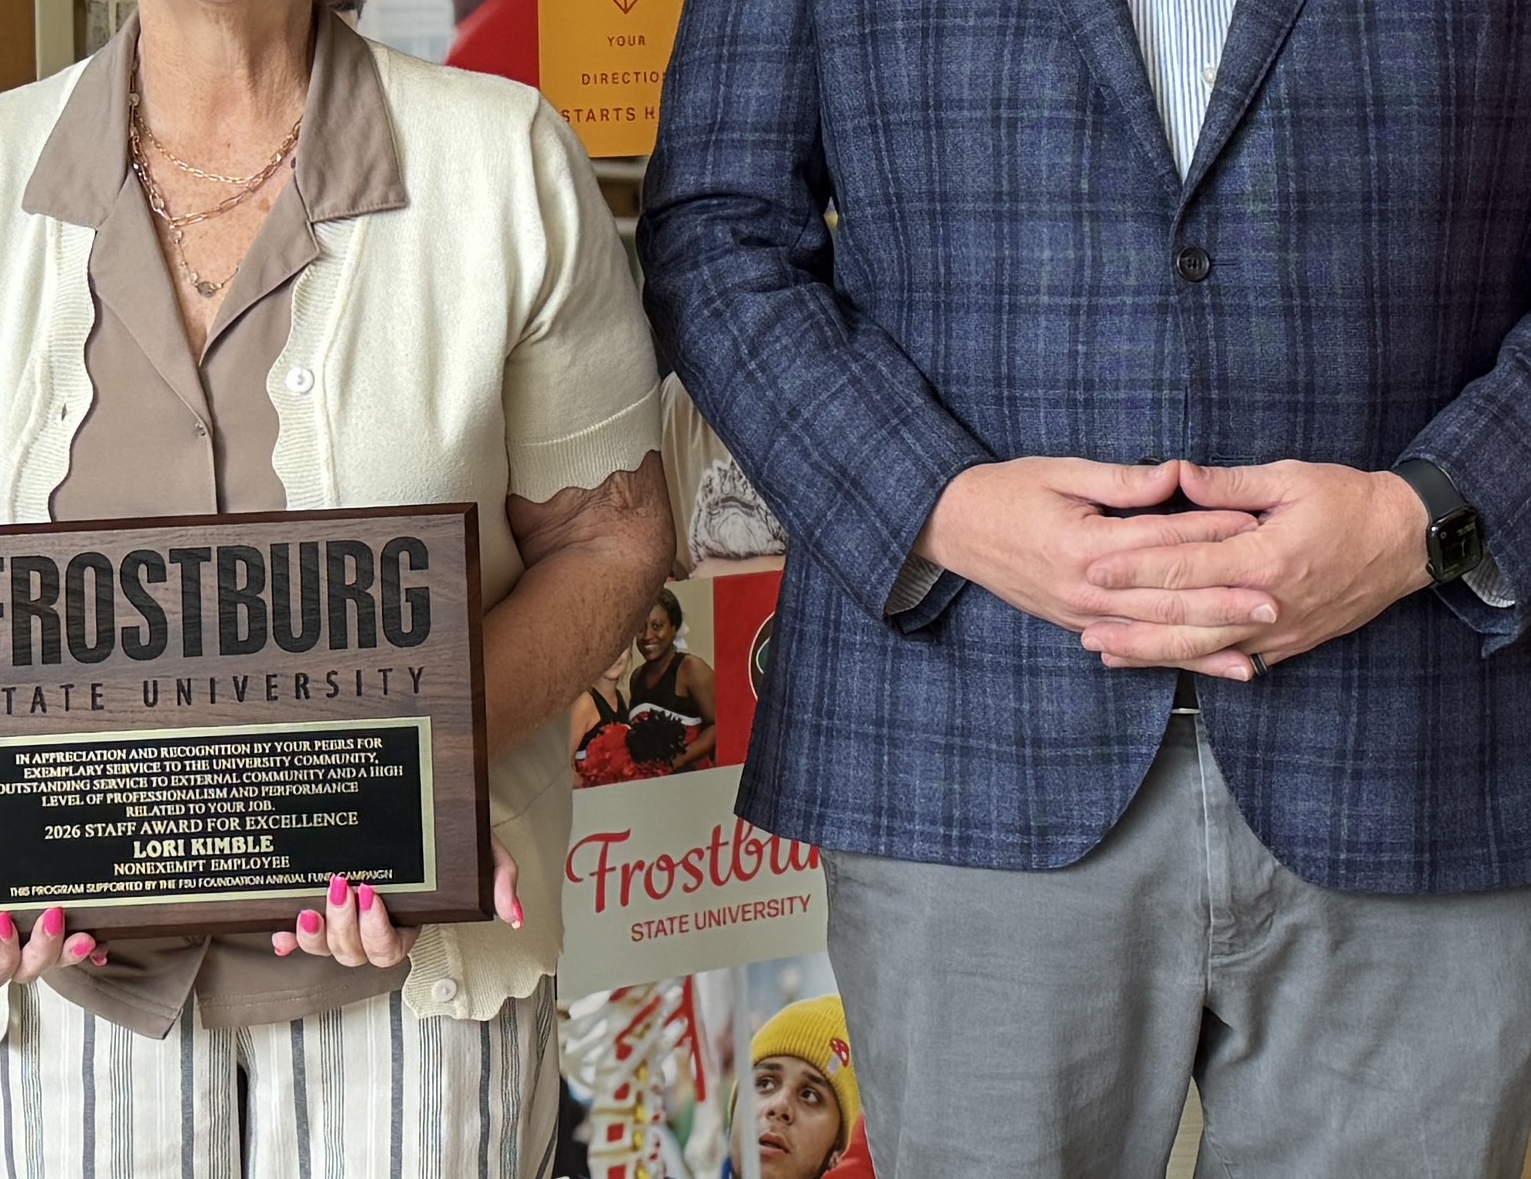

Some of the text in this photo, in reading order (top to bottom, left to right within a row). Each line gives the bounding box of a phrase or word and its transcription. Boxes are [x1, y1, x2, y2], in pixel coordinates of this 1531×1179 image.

[607, 35, 647, 47] YOUR
[581, 71, 667, 86] DIRECTIO
[561, 107, 636, 123] STARTS
[143, 666, 426, 709] UNIVERSITY
[15, 736, 383, 765] IN APPRECIATION AND RECOGNITION BY YOUR PEERS FOR
[23, 763, 104, 779] EXEMPLARY
[105, 761, 162, 775] SERVICE
[162, 760, 182, 772] TO
[182, 758, 210, 771] THE
[212, 755, 291, 770] UNIVERSITY
[92, 776, 148, 790] SERVICE
[149, 775, 168, 787] TO
[170, 772, 241, 786] EXTERNAL
[241, 768, 325, 783] COMMUNITY
[326, 766, 356, 779] AND
[369, 764, 403, 777] HIGH
[41, 780, 359, 807] LEVEL OF PROFESSIONALISM AND PERFORMANCE
[125, 803, 186, 817] RELATED
[186, 802, 206, 814] TO
[206, 800, 246, 813] YOUR
[43, 811, 359, 839] 2026 STAFF AWARD FOR EXCELLENCE
[132, 834, 274, 859] LORI KIMBLE
[113, 855, 290, 876] NONEXEMPT EMPLOYEE
[630, 894, 812, 943] STATE UNIVERSITY
